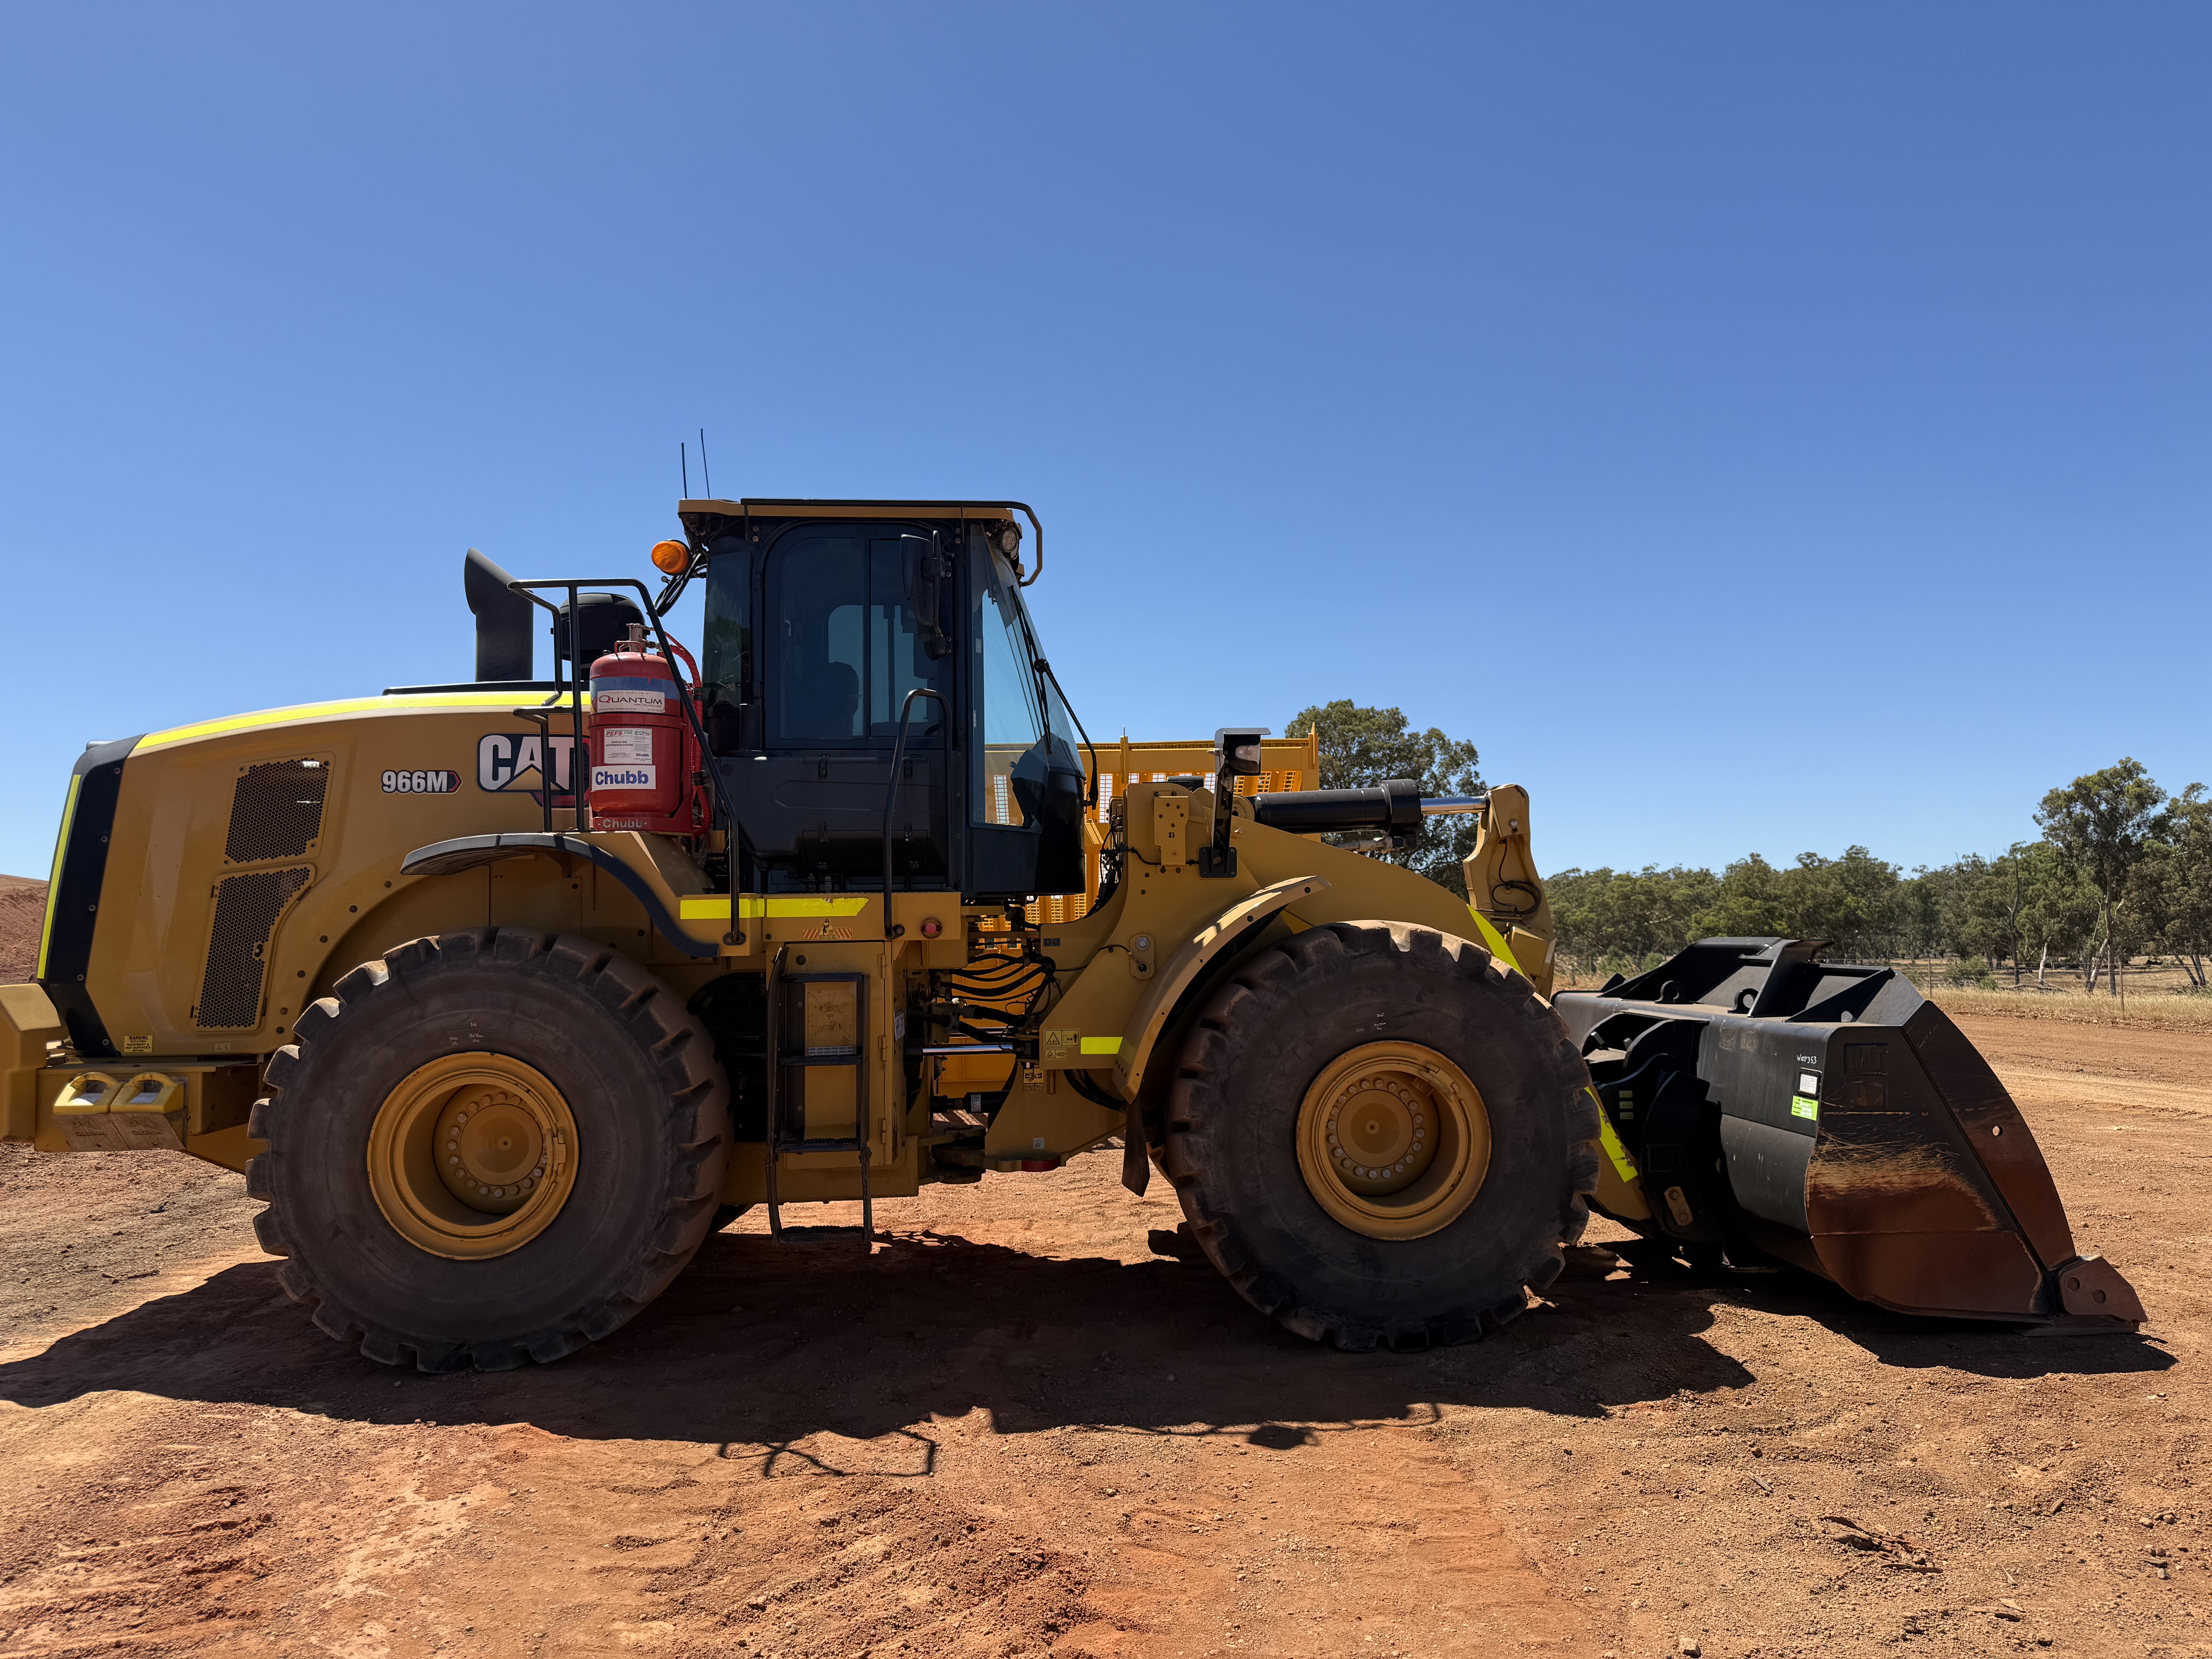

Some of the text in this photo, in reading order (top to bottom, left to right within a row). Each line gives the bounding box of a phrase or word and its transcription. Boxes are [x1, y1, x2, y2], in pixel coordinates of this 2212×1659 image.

[599, 695, 662, 705] QUANTUM
[480, 735, 575, 790] CAT
[383, 771, 447, 792] 966M
[596, 770, 649, 785] Chubb
[603, 818, 643, 828] Chubb
